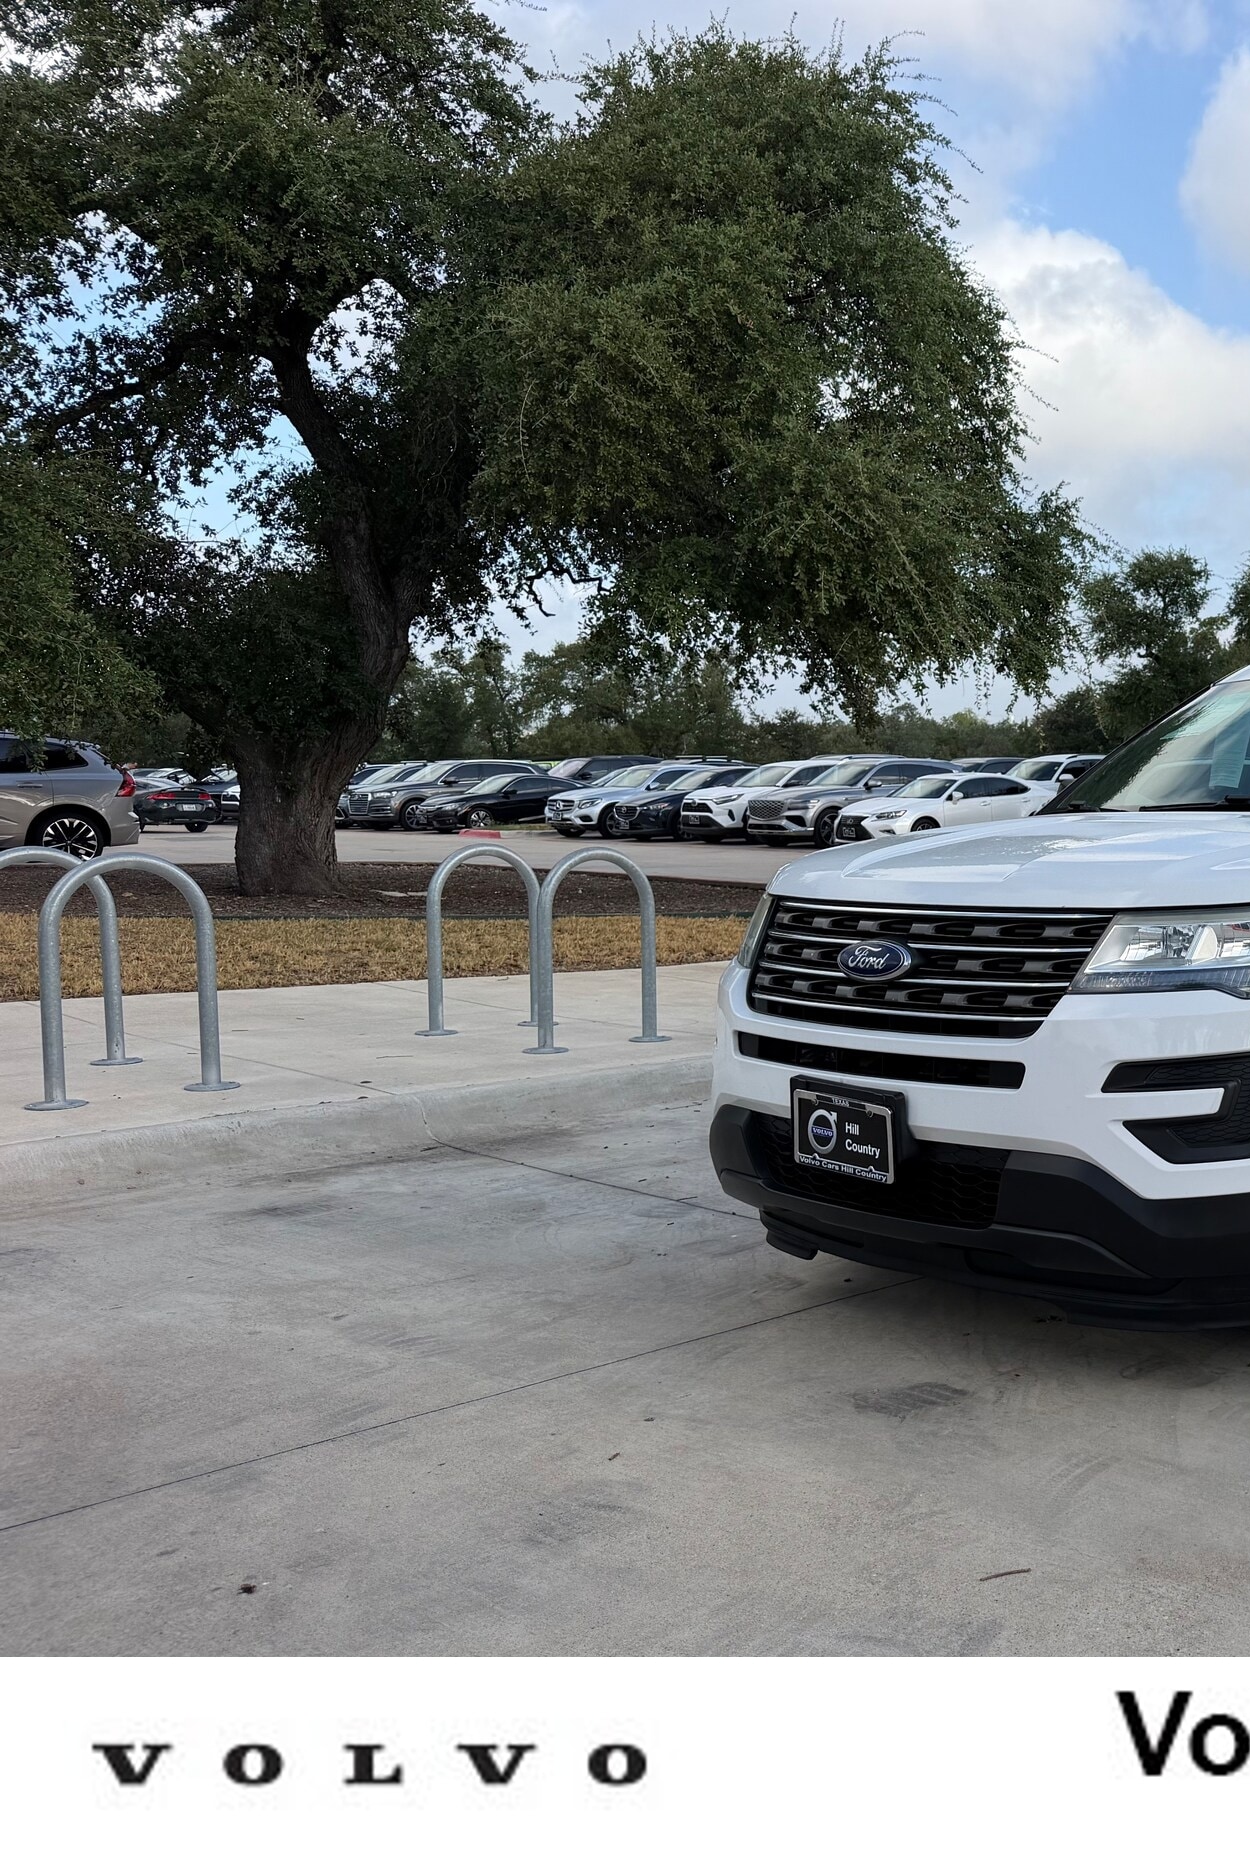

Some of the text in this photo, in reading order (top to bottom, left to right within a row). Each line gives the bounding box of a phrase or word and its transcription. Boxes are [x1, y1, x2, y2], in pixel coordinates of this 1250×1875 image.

[848, 945, 890, 969] Ford
[812, 1127, 833, 1136] VOLVO
[845, 1122, 860, 1136] Hill
[845, 1139, 880, 1159] Country
[800, 1156, 886, 1182] Volvo Cars Hill Country
